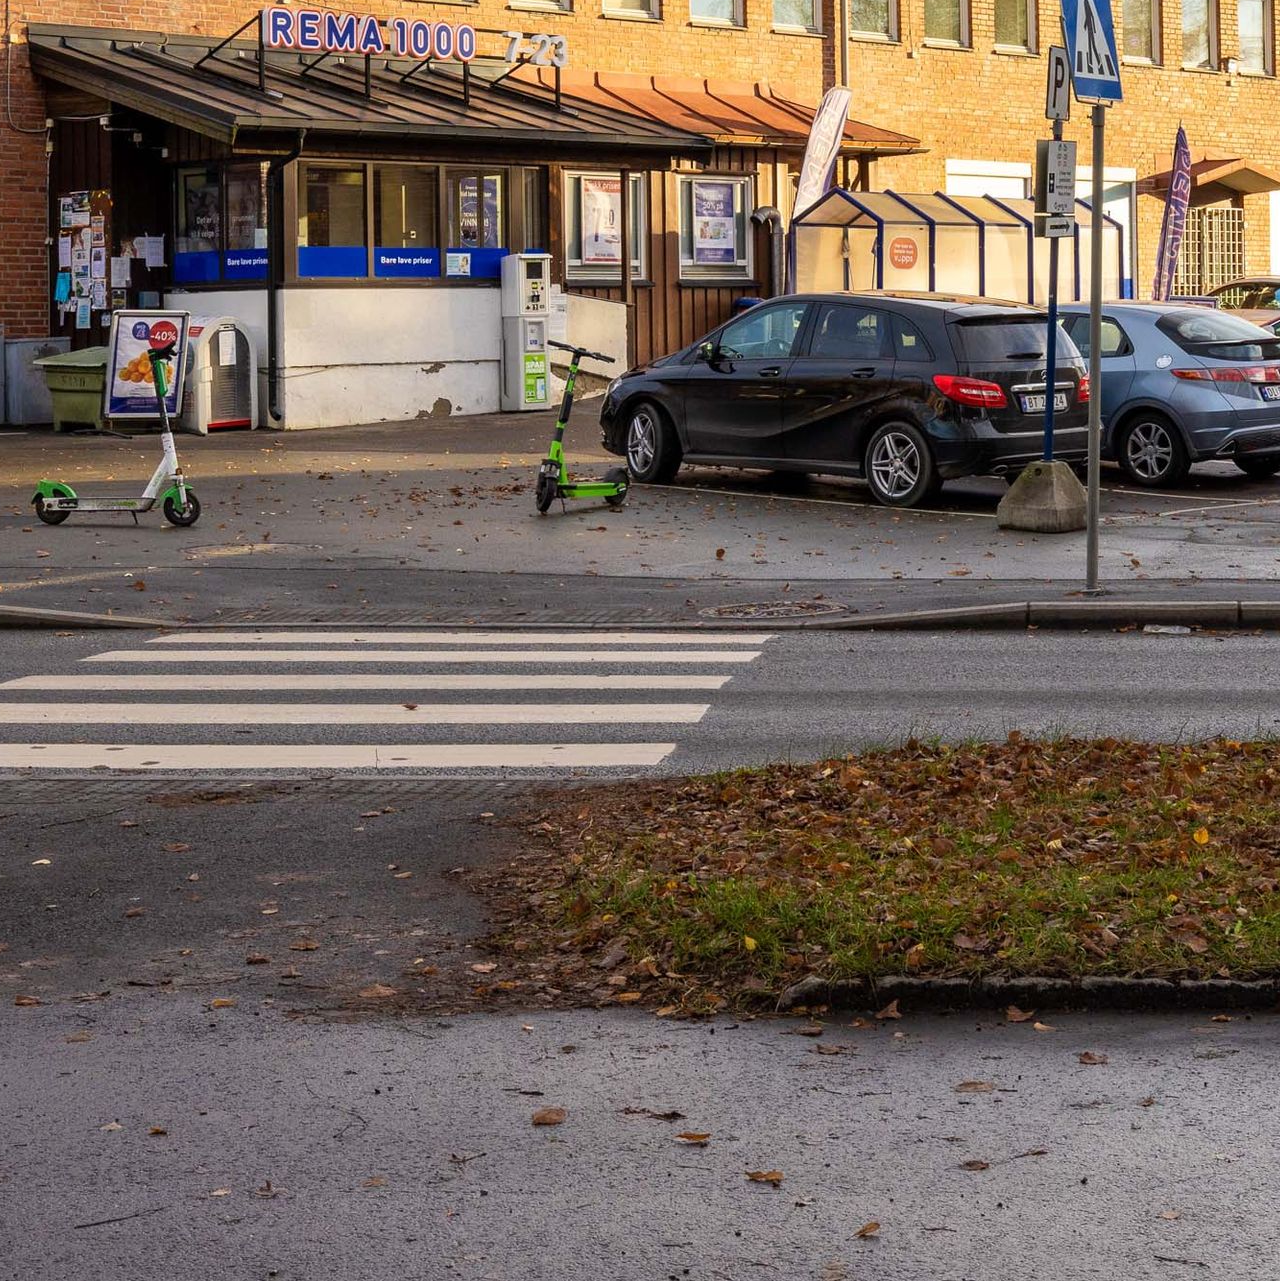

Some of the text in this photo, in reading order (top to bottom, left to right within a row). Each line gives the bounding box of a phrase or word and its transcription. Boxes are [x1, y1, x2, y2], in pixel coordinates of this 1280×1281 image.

[266, 7, 569, 67] REMA 1000 7-23
[1052, 56, 1065, 109] P
[227, 258, 240, 266] Bare
[240, 257, 252, 265] lave
[380, 255, 433, 266] Bare lave priser
[150, 330, 177, 341] -40%
[1040, 395, 1064, 407] 224
